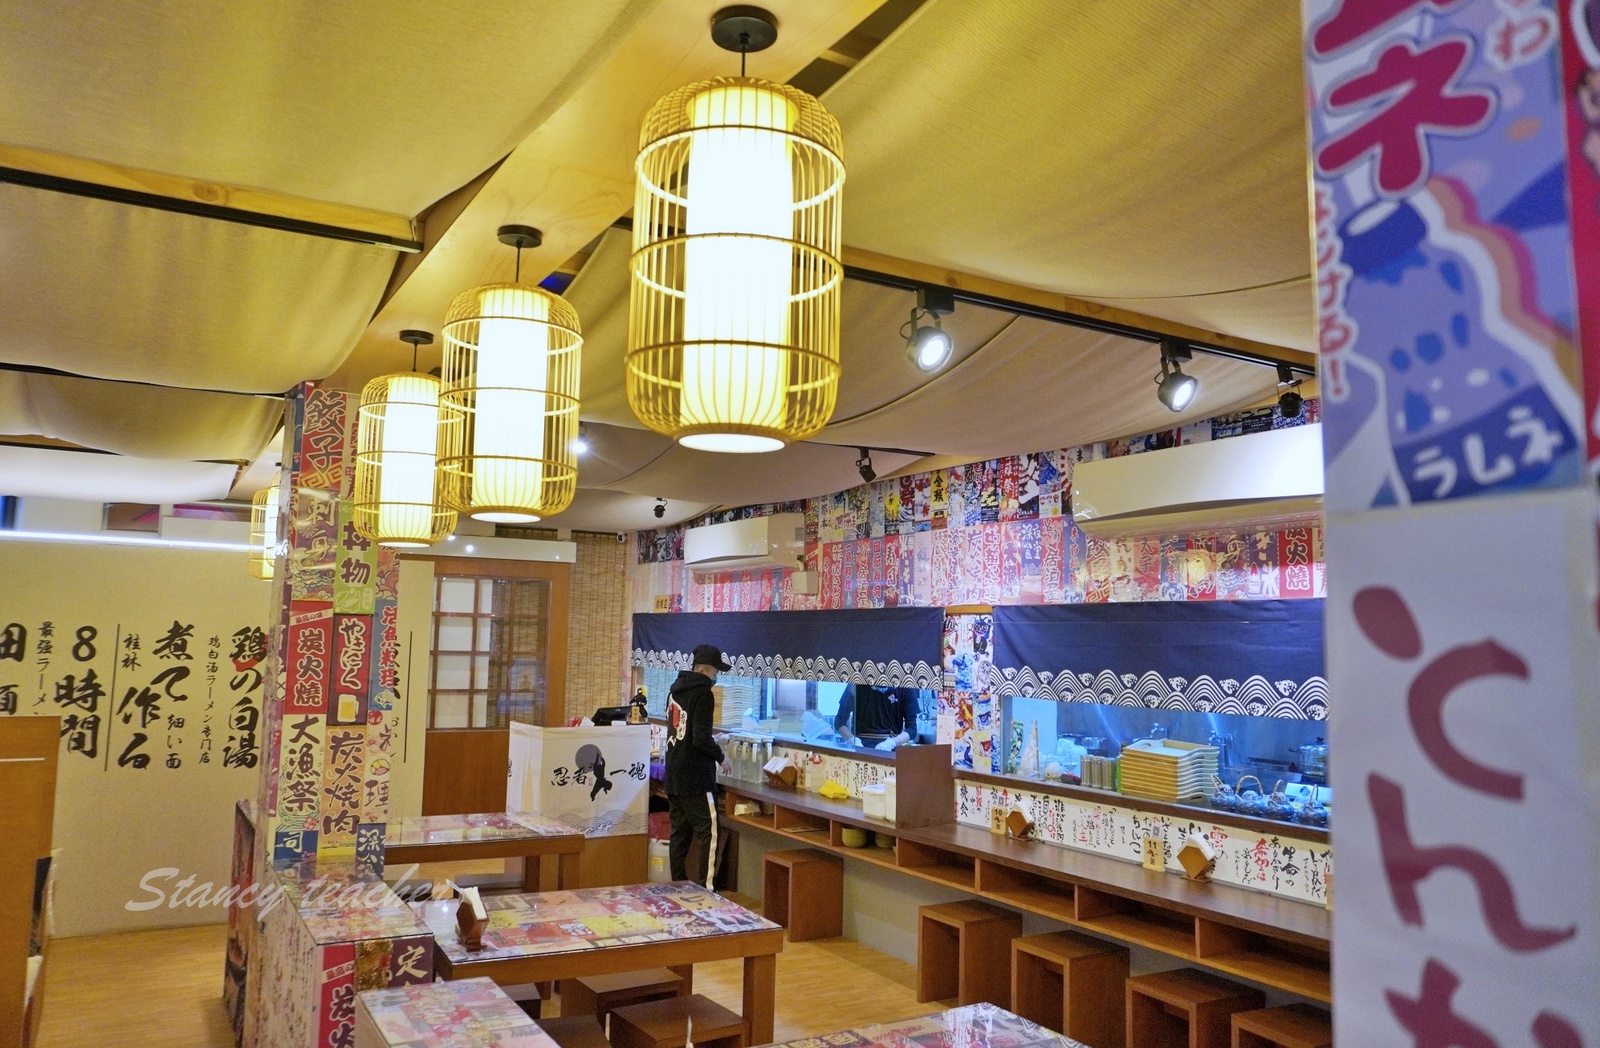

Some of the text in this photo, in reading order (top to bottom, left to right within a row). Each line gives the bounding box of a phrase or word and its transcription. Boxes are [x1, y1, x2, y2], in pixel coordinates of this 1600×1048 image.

[304, 388, 345, 474] 餃子
[304, 497, 335, 562] 刺身
[32, 621, 55, 715] 最强ラーメ
[53, 625, 106, 759] 8時間
[151, 619, 195, 702] 煮て
[222, 626, 268, 769] 鶏の白湯
[282, 714, 321, 813] 大漁祭
[551, 766, 588, 786] 忍者
[609, 762, 647, 781] 一魂
[995, 808, 1003, 816] 10
[1147, 840, 1157, 849] 11
[395, 945, 428, 986] 定
